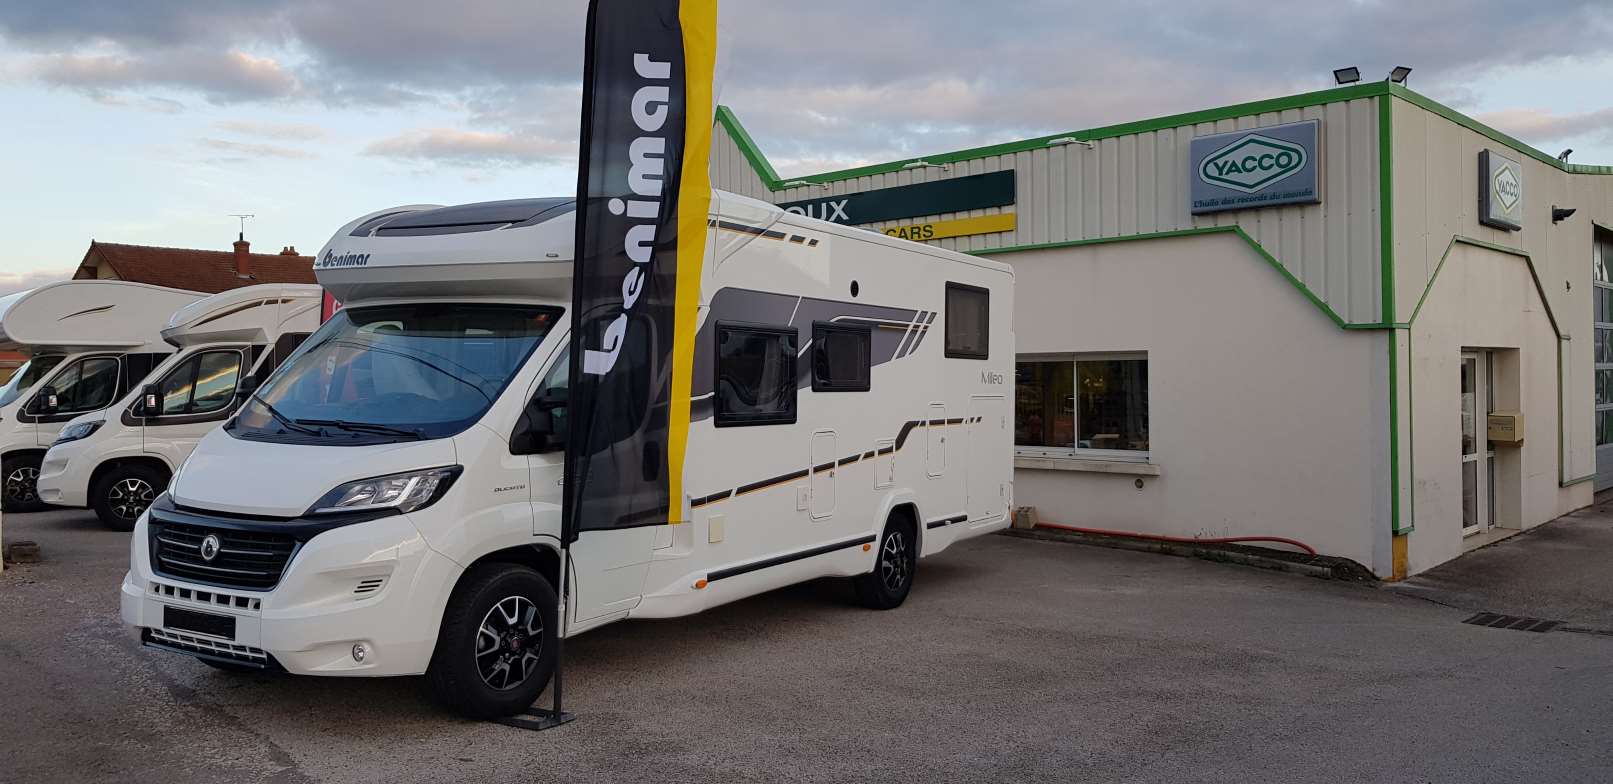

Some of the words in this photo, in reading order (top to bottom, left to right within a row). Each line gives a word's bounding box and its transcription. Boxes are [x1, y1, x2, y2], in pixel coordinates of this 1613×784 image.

[1213, 151, 1293, 177] YACCO
[1497, 179, 1518, 198] YACCO
[584, 53, 671, 375] benimar
[323, 248, 371, 267] benimar
